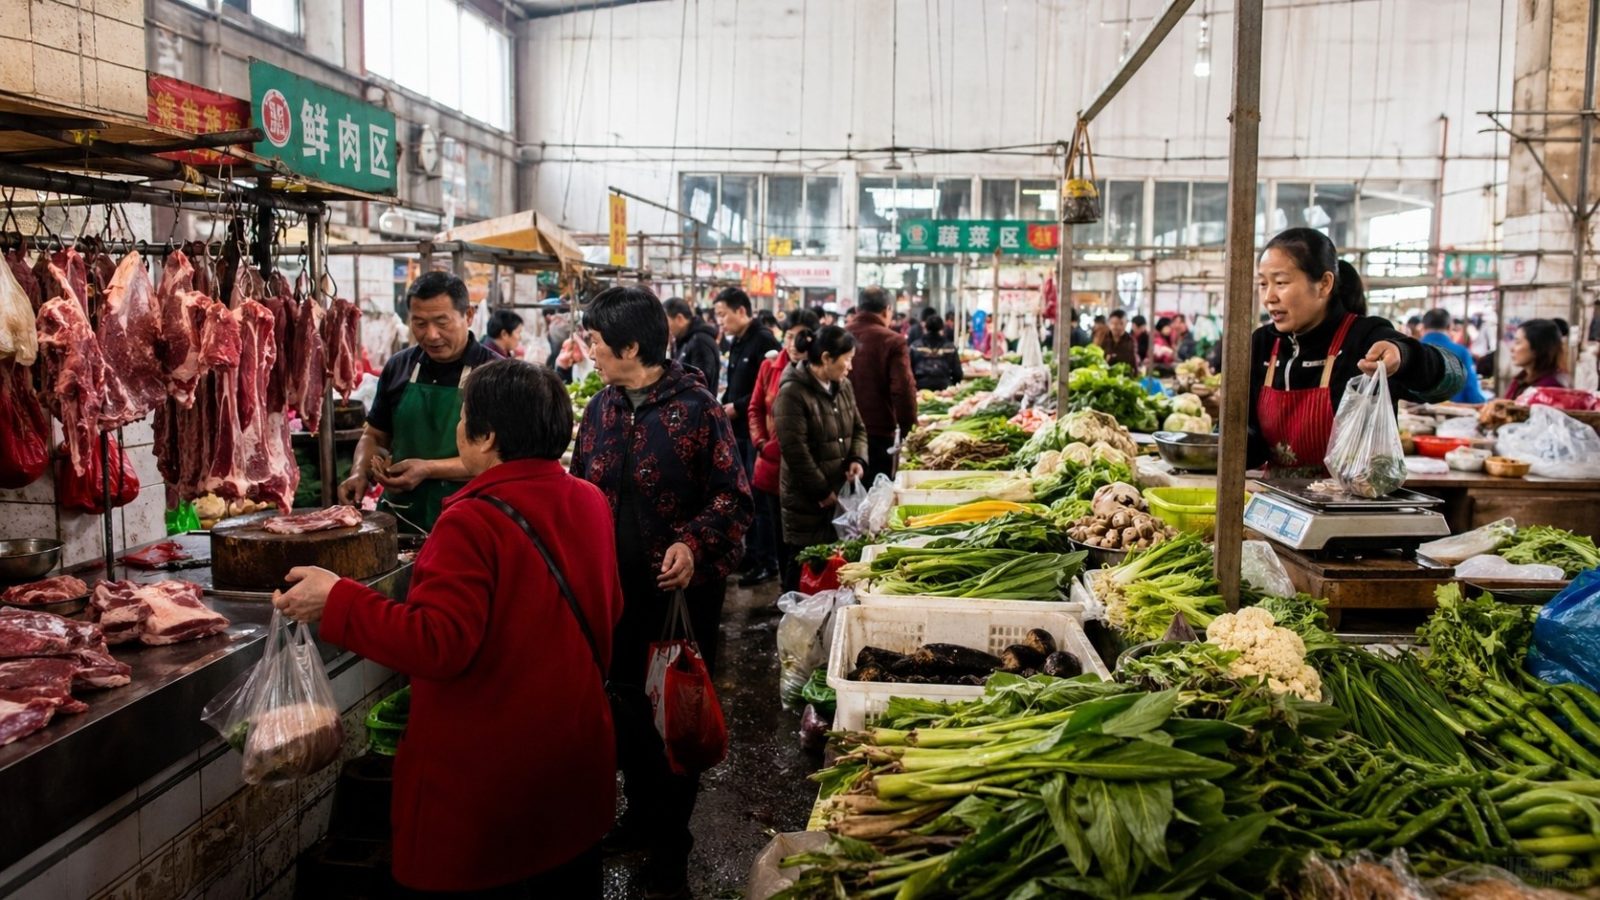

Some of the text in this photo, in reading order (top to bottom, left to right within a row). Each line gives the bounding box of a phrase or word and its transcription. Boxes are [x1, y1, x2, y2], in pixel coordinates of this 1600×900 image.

[301, 98, 391, 179] 鲜肉区
[937, 225, 1020, 248] 蔬菜区
